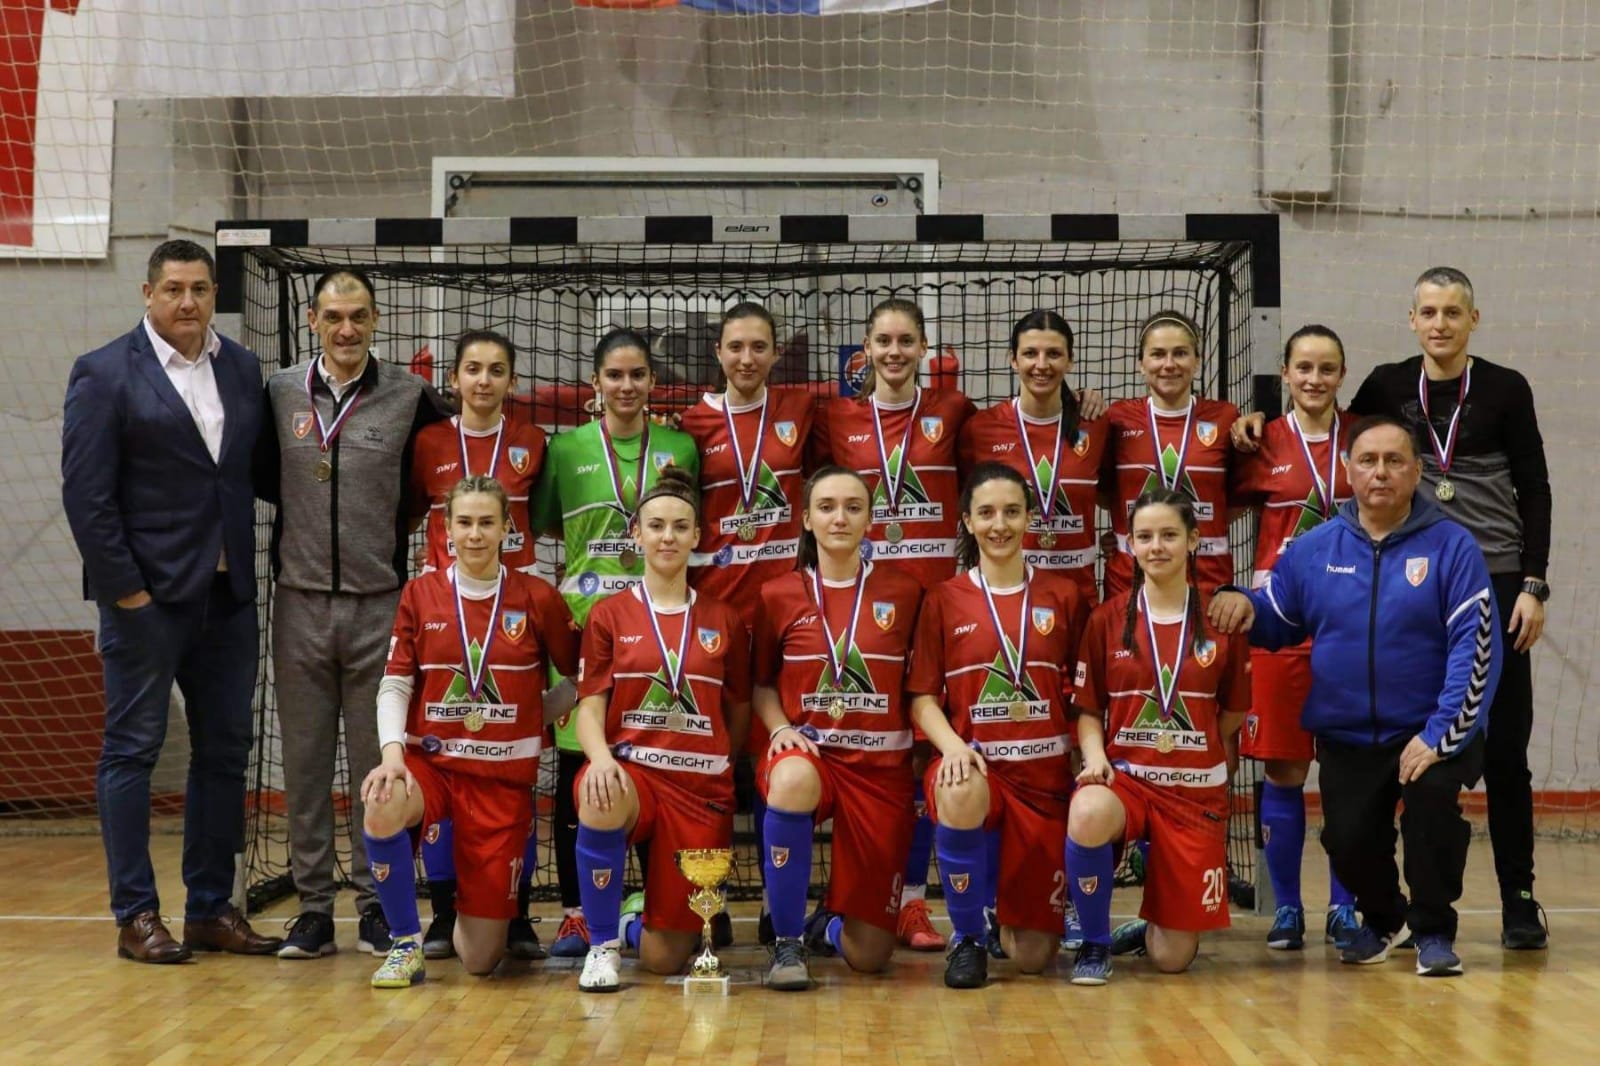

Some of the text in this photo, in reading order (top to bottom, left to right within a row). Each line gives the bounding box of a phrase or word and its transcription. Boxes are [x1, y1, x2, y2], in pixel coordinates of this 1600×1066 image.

[724, 223, 770, 233] elan
[1025, 554, 1083, 565] IONEIGHT
[1326, 562, 1357, 574] hummel
[1049, 869, 1066, 905] 2
[1201, 866, 1224, 905] 20
